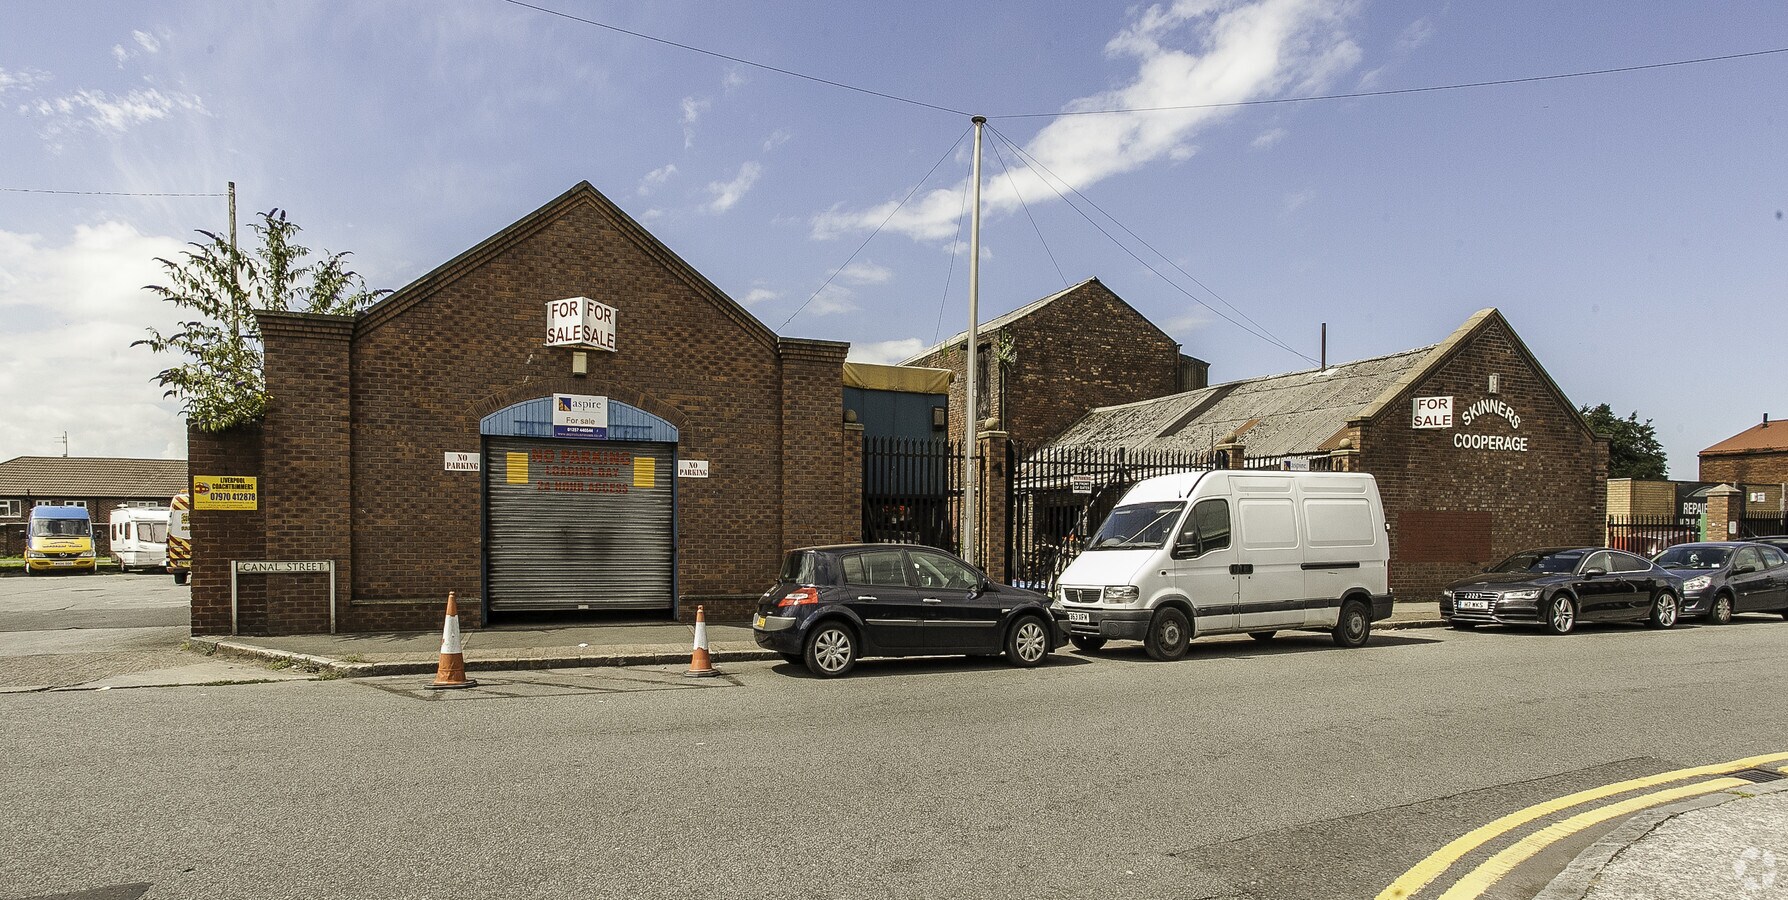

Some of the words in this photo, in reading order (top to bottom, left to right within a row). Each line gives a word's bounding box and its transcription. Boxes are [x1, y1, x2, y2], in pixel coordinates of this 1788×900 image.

[552, 301, 578, 319] FOR
[587, 301, 612, 325] FOR
[547, 325, 581, 344] SALE
[583, 325, 614, 349] SALE
[572, 399, 601, 411] aspire
[1418, 398, 1448, 410] FOR
[566, 416, 578, 424] For
[1462, 399, 1521, 429] SKINNERS
[1413, 415, 1451, 426] SALE
[1454, 433, 1528, 452] COOPERAGE
[457, 453, 468, 462] NO
[532, 448, 555, 463] NO
[560, 449, 630, 466] PARKING
[446, 462, 479, 470] PARKING
[689, 461, 698, 469] NO
[588, 482, 629, 494] ACCESS
[210, 493, 231, 501] 07970
[243, 562, 281, 572] CANAL
[286, 562, 324, 571] STREET
